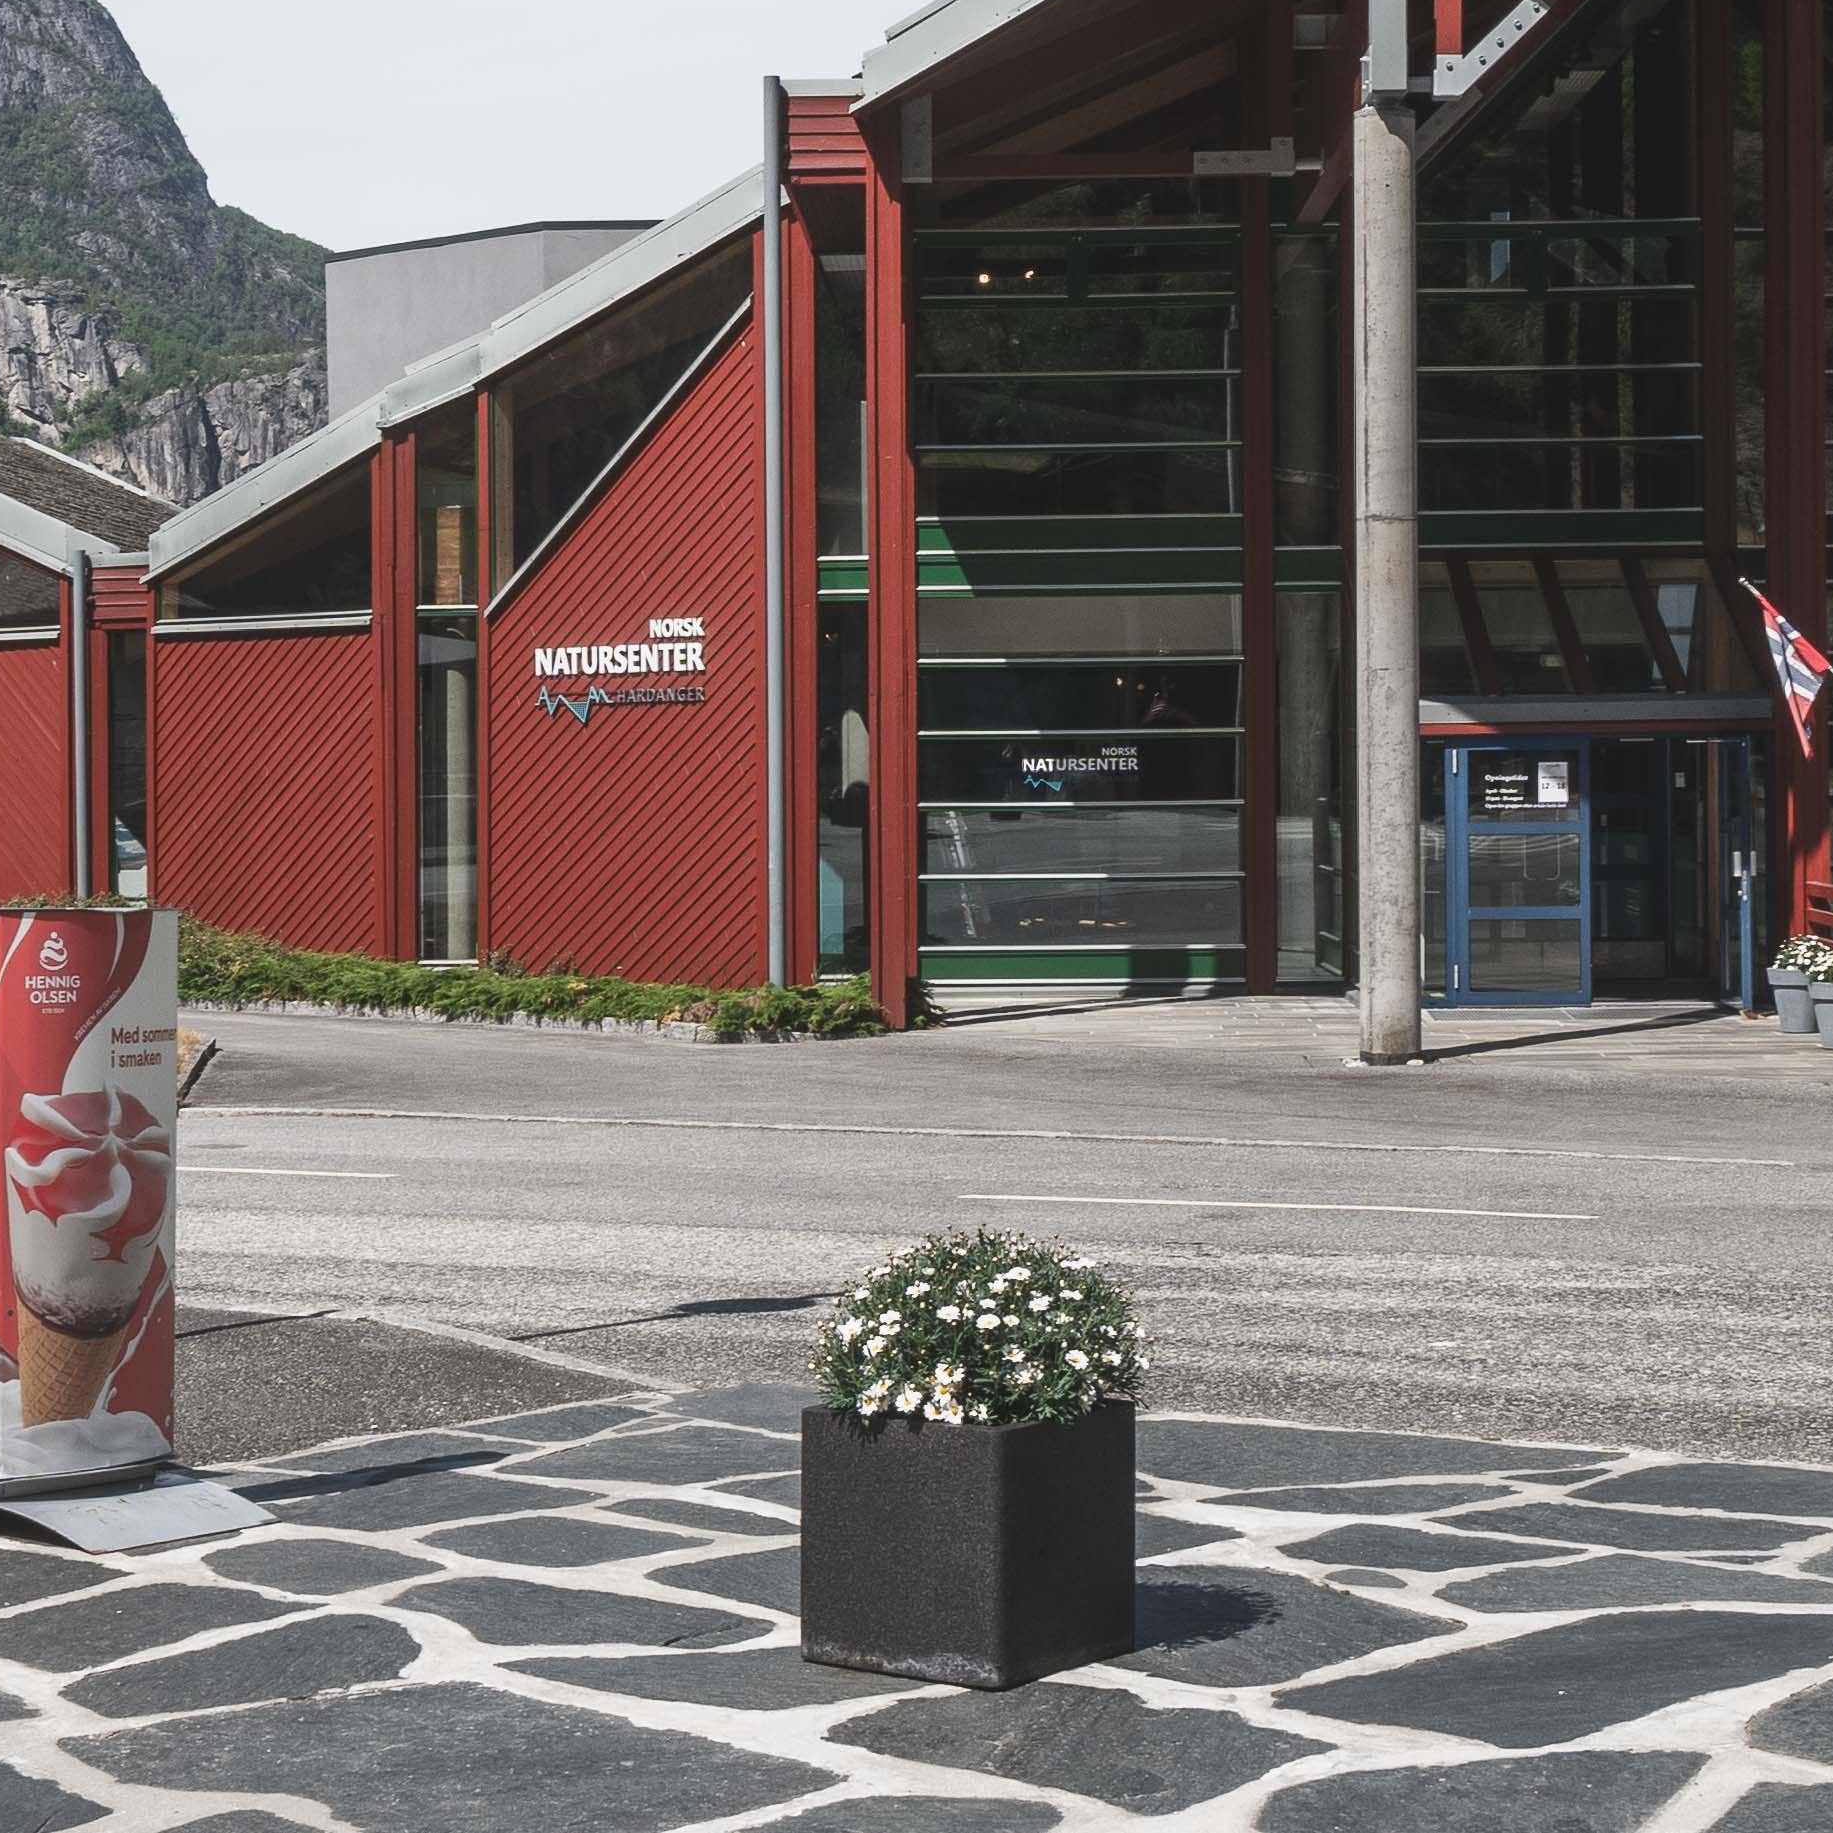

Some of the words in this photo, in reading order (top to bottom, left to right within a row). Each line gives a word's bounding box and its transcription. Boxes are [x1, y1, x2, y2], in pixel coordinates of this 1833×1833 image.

[649, 617, 706, 639] NORSK
[534, 642, 706, 676] NATURSENTER
[617, 686, 706, 703] HARDANGER
[1101, 746, 1137, 756] NORSK
[1021, 757, 1139, 772] NATURSENTER
[24, 975, 81, 989] HENNIG
[29, 990, 77, 1004] OLSEN
[111, 1026, 140, 1045] Med
[111, 1050, 115, 1069] i
[118, 1049, 162, 1068] smaken
